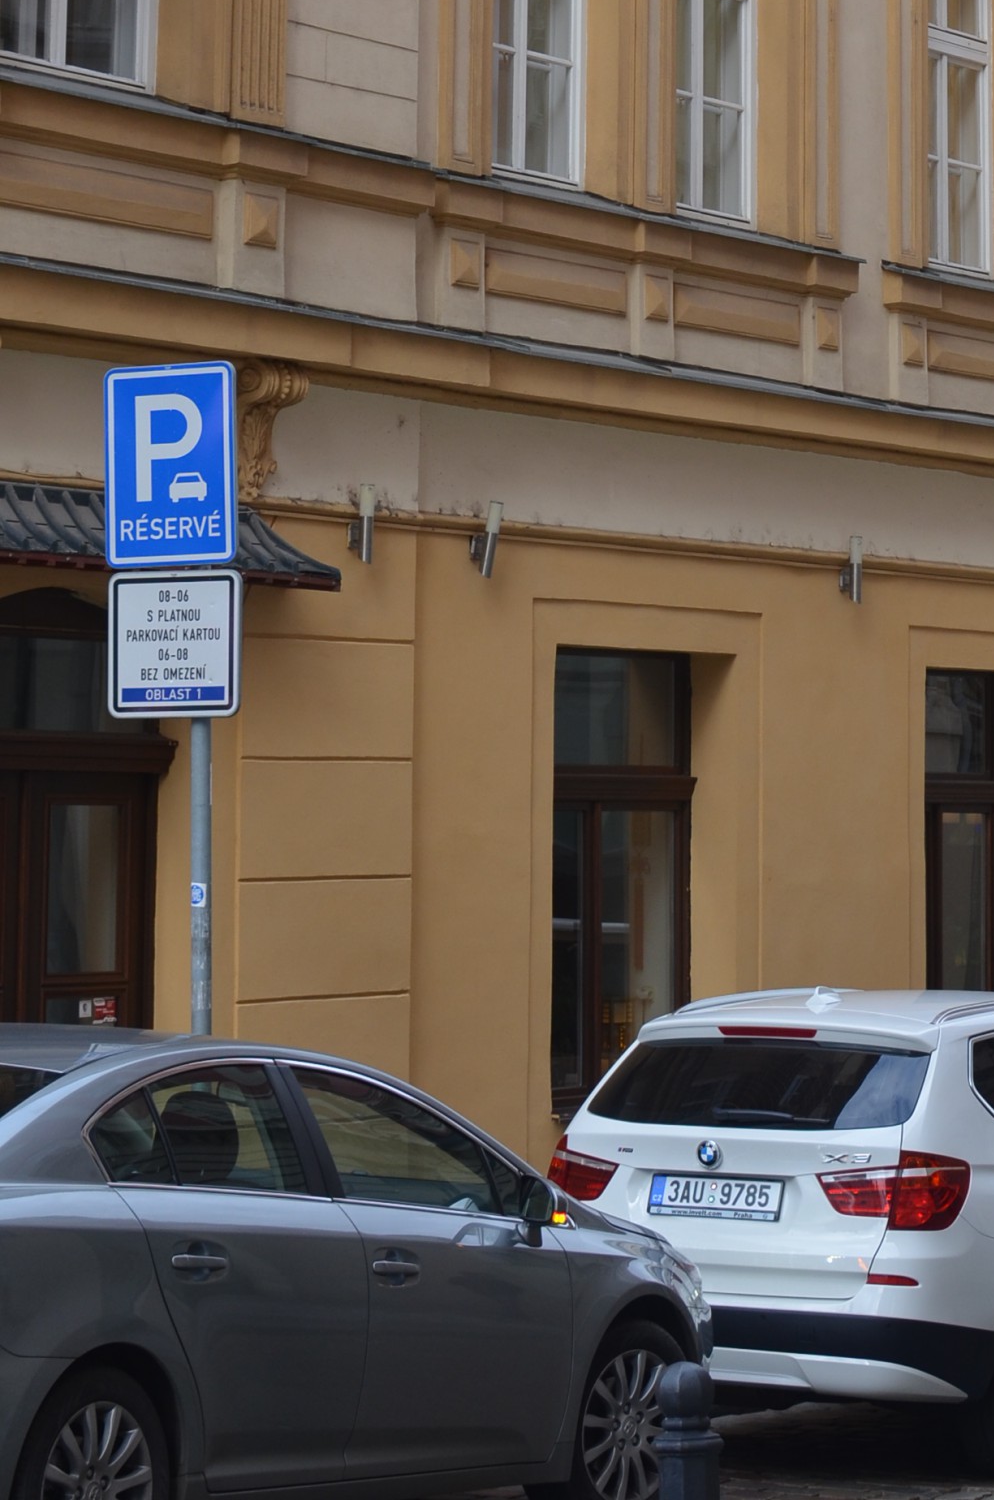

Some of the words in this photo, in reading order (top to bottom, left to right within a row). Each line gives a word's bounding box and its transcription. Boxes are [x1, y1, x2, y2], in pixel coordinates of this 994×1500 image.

[134, 393, 203, 503] P
[120, 510, 221, 541] RÉSERVÉ
[158, 589, 190, 603] 08-06
[147, 609, 154, 623] S
[157, 608, 201, 622] PLATNOU
[126, 625, 180, 643] PARKOVACÍ
[182, 627, 221, 641] KARTOU
[158, 647, 189, 661] 06-08
[140, 667, 159, 681] BEZ
[163, 663, 207, 680] OMEZENÍ
[145, 688, 192, 701] OBLAST
[196, 688, 202, 700] 1
[821, 1153, 872, 1164] X3
[652, 1194, 663, 1202] CZ
[667, 1180, 706, 1204] 3AU
[719, 1182, 771, 1208] 9785
[733, 1211, 754, 1219] Praha
